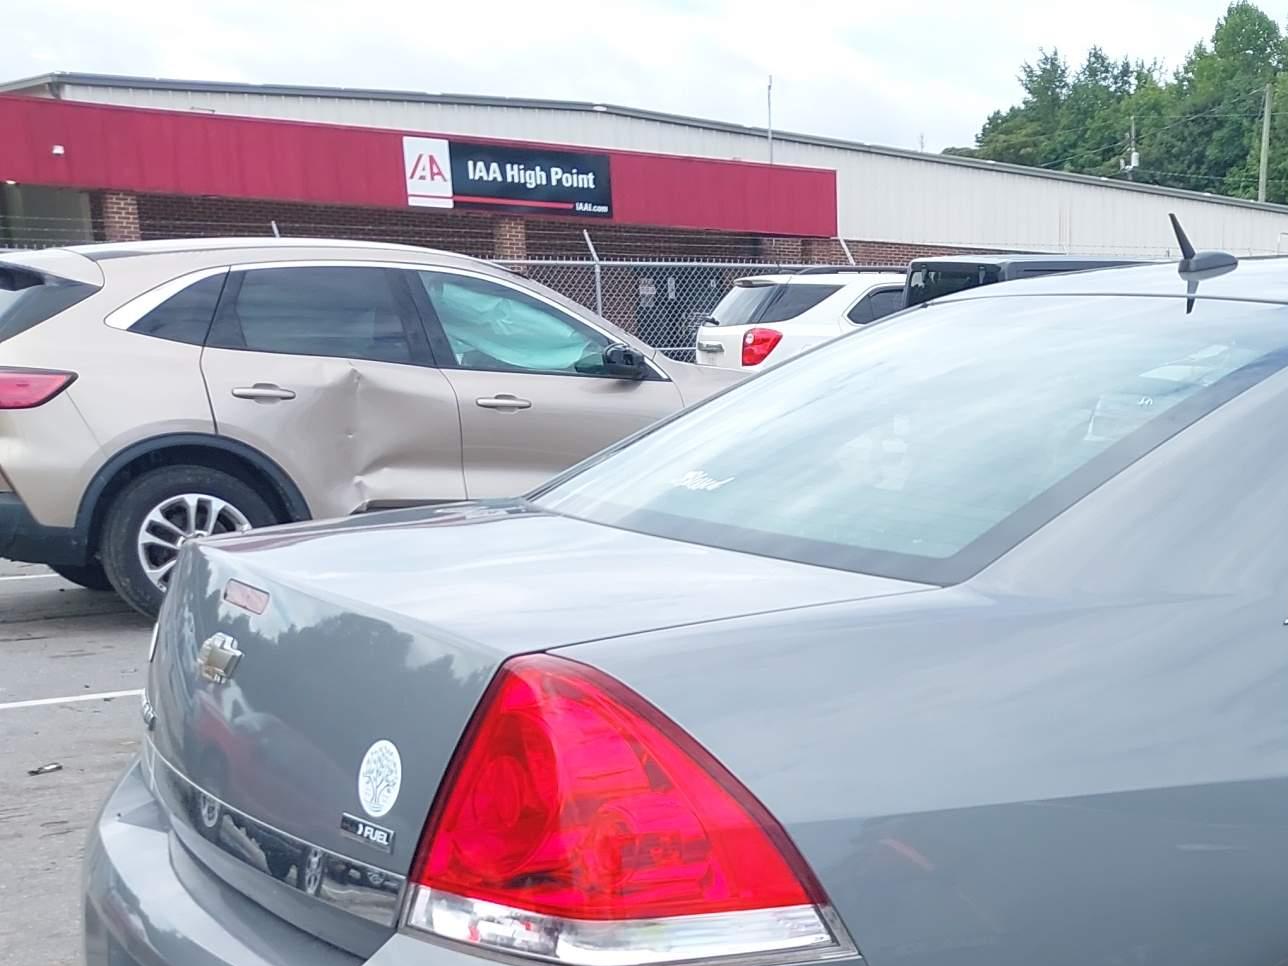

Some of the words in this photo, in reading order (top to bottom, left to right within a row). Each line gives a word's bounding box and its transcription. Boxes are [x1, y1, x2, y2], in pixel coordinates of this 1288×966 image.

[467, 160, 503, 183] IAA
[506, 163, 547, 189] High
[551, 166, 596, 189] Point
